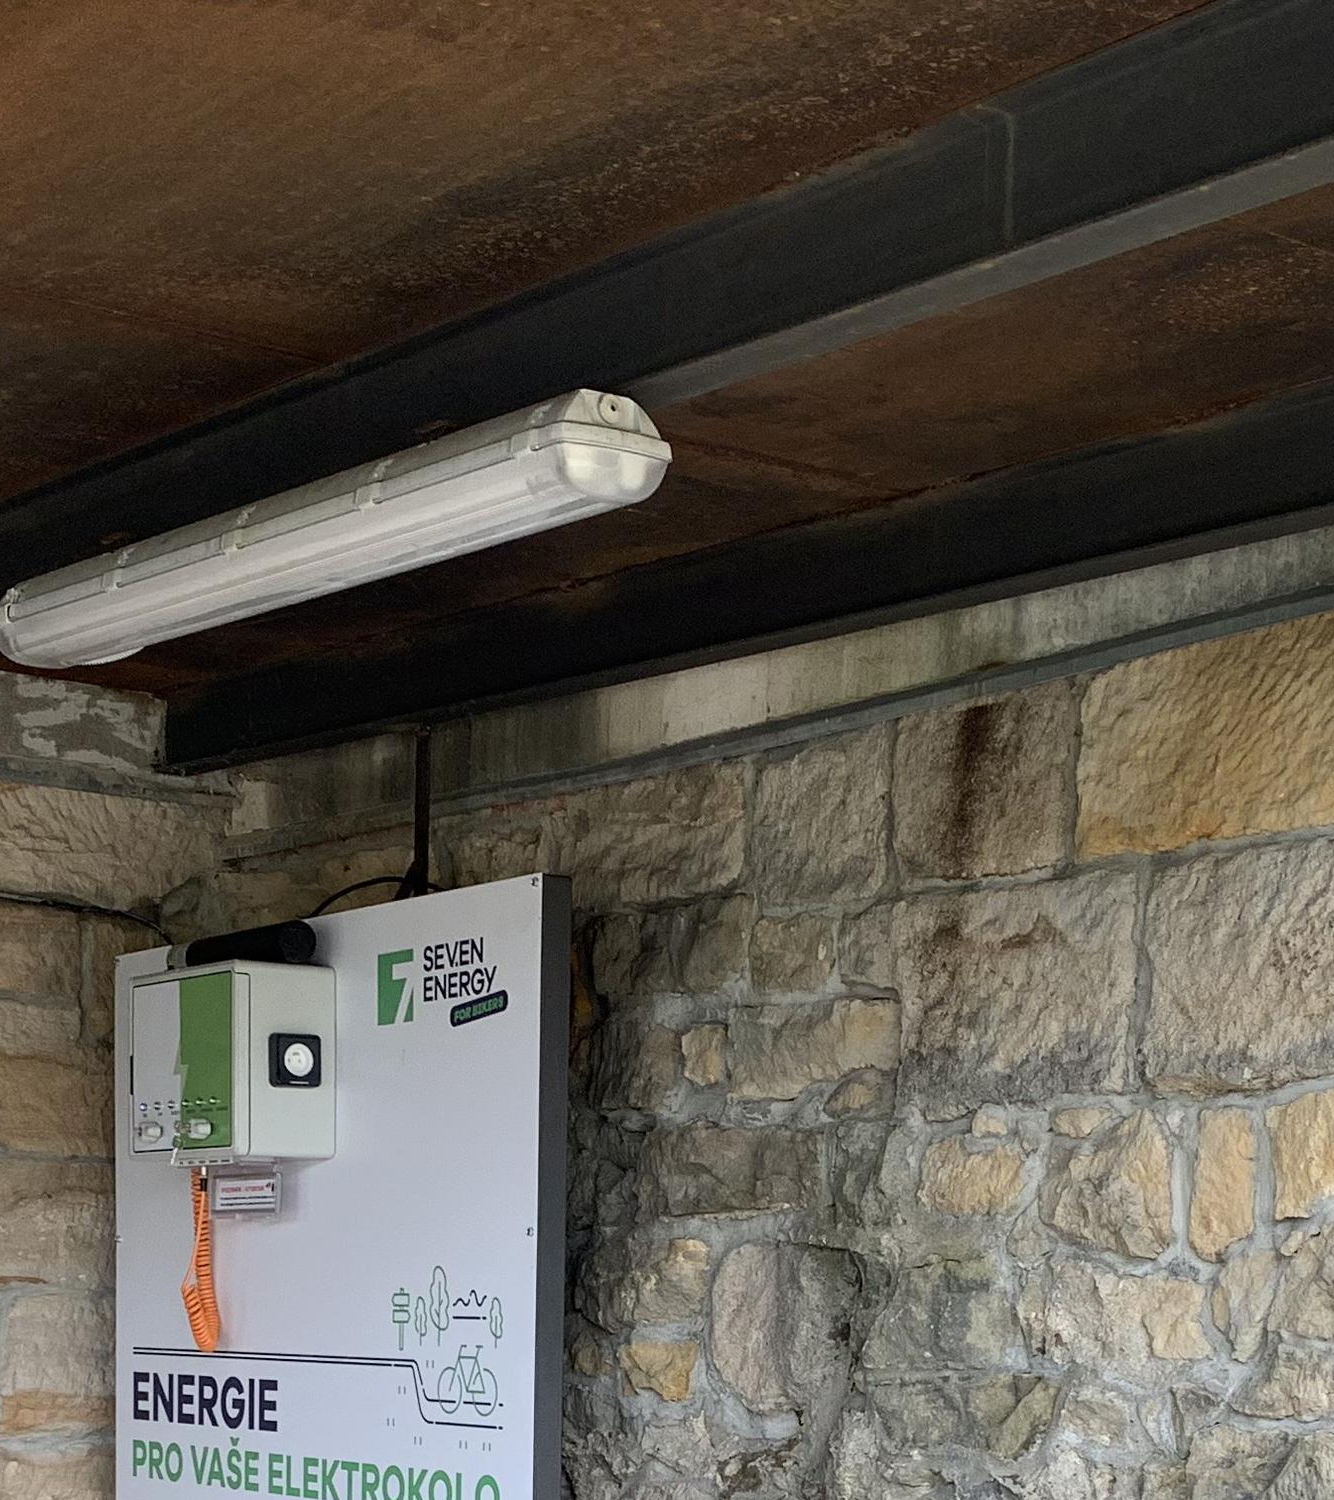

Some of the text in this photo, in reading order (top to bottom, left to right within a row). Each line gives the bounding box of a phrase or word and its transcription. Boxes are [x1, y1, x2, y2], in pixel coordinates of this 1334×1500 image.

[423, 965, 497, 1002] ENERGY
[454, 996, 504, 1022] FOR BIKERS
[133, 1371, 278, 1432] ENERGIE
[132, 1439, 183, 1482] PRO
[190, 1436, 259, 1492] VAŠE
